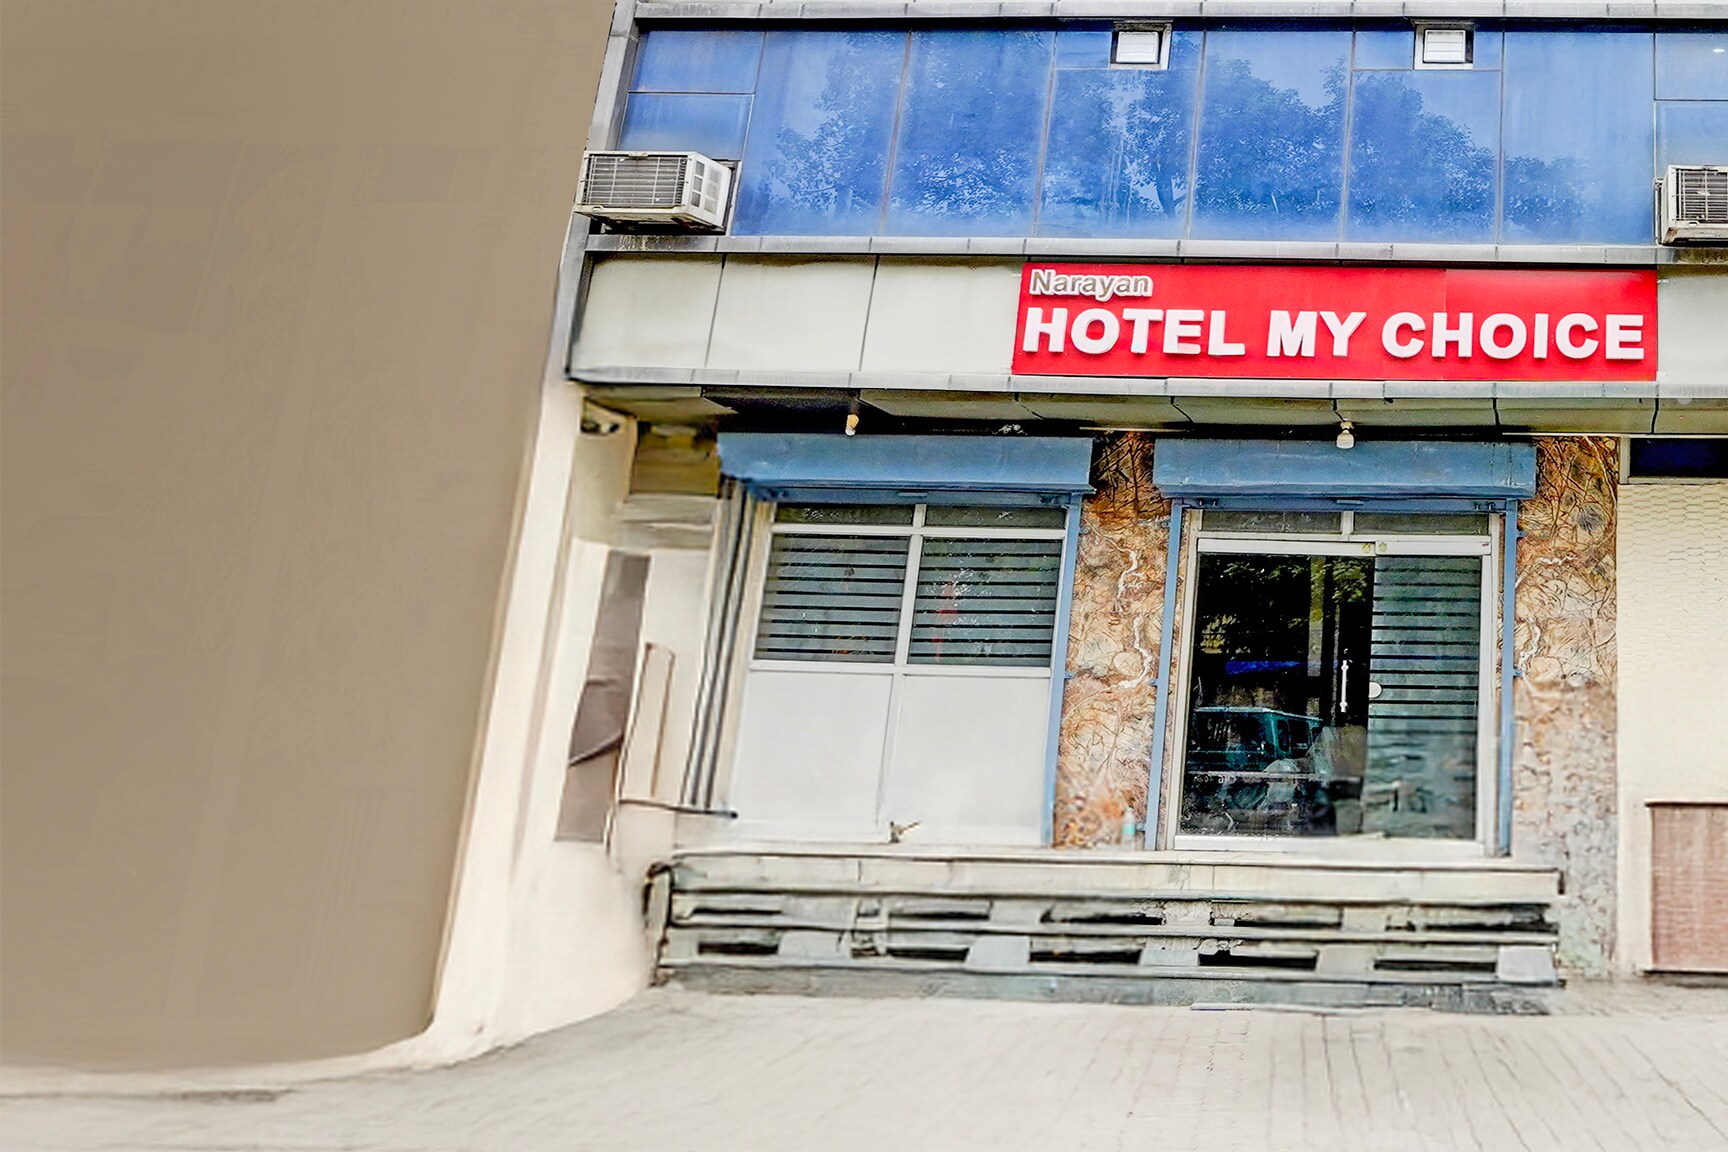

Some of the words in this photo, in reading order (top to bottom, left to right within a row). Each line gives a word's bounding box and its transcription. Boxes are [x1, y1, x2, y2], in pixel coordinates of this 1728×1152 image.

[1029, 269, 1153, 301] Narayan
[1022, 307, 1246, 355] HOTEL
[1266, 310, 1367, 357] MY
[1381, 312, 1645, 360] CHOICE
